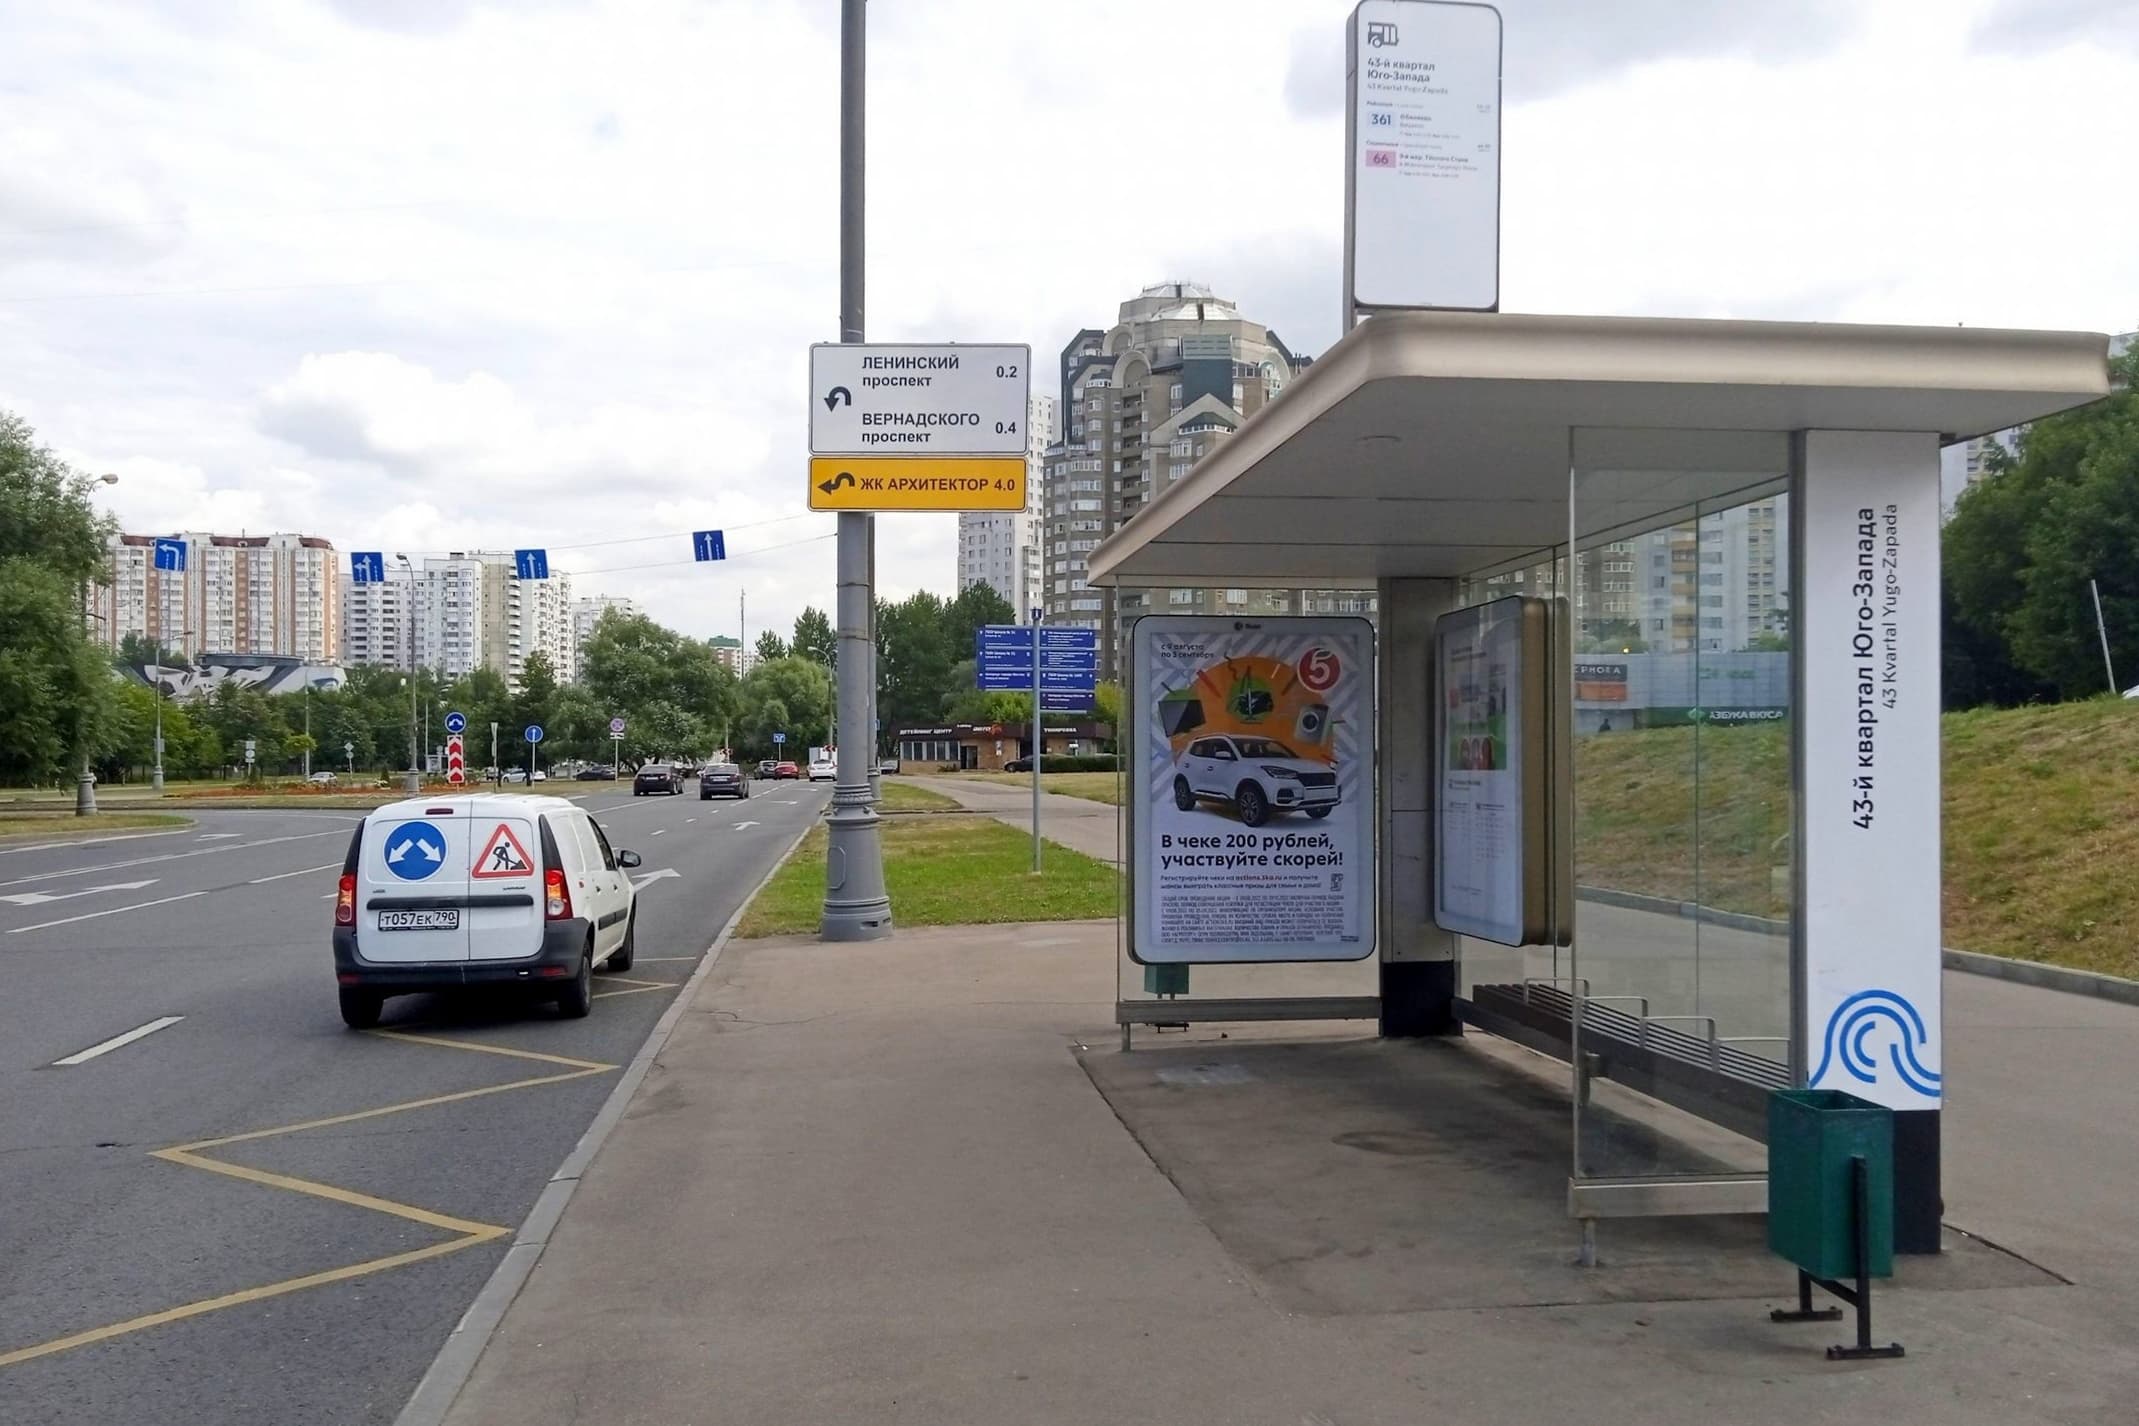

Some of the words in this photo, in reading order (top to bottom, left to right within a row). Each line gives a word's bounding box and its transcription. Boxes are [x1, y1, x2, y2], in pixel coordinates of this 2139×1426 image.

[1367, 57, 1390, 68] 43-й
[1393, 60, 1435, 72] квартал
[1367, 69, 1430, 83] Юго-Запада
[1371, 113, 1391, 126] 361
[1372, 152, 1389, 165] 66
[862, 354, 959, 369] ЛЕНИНСКИЙ
[996, 365, 1018, 378] 0.2
[862, 376, 932, 389] проспект
[862, 413, 980, 428] ВЕРНАДСКОГО
[995, 422, 1016, 434] 0.4
[862, 432, 931, 445] проспект
[860, 478, 883, 491] ЖК
[888, 478, 988, 491] АРХИТЕКТОР
[994, 478, 1015, 491] 4.0
[1882, 504, 1900, 617] Yugo-Zapada
[1852, 507, 1877, 658] Юго-Запада
[1882, 622, 1897, 683] Kvartal
[1883, 687, 1897, 709] 43
[1857, 667, 1878, 767] квартал
[1853, 775, 1875, 829] 43-й
[1162, 834, 1172, 848] В
[1178, 837, 1222, 848] чеке
[1226, 834, 1258, 848] 200
[1263, 833, 1334, 851] рублей,
[1161, 851, 1268, 869] участвуйте
[1273, 851, 1343, 869] скорей!
[435, 911, 455, 922] 790
